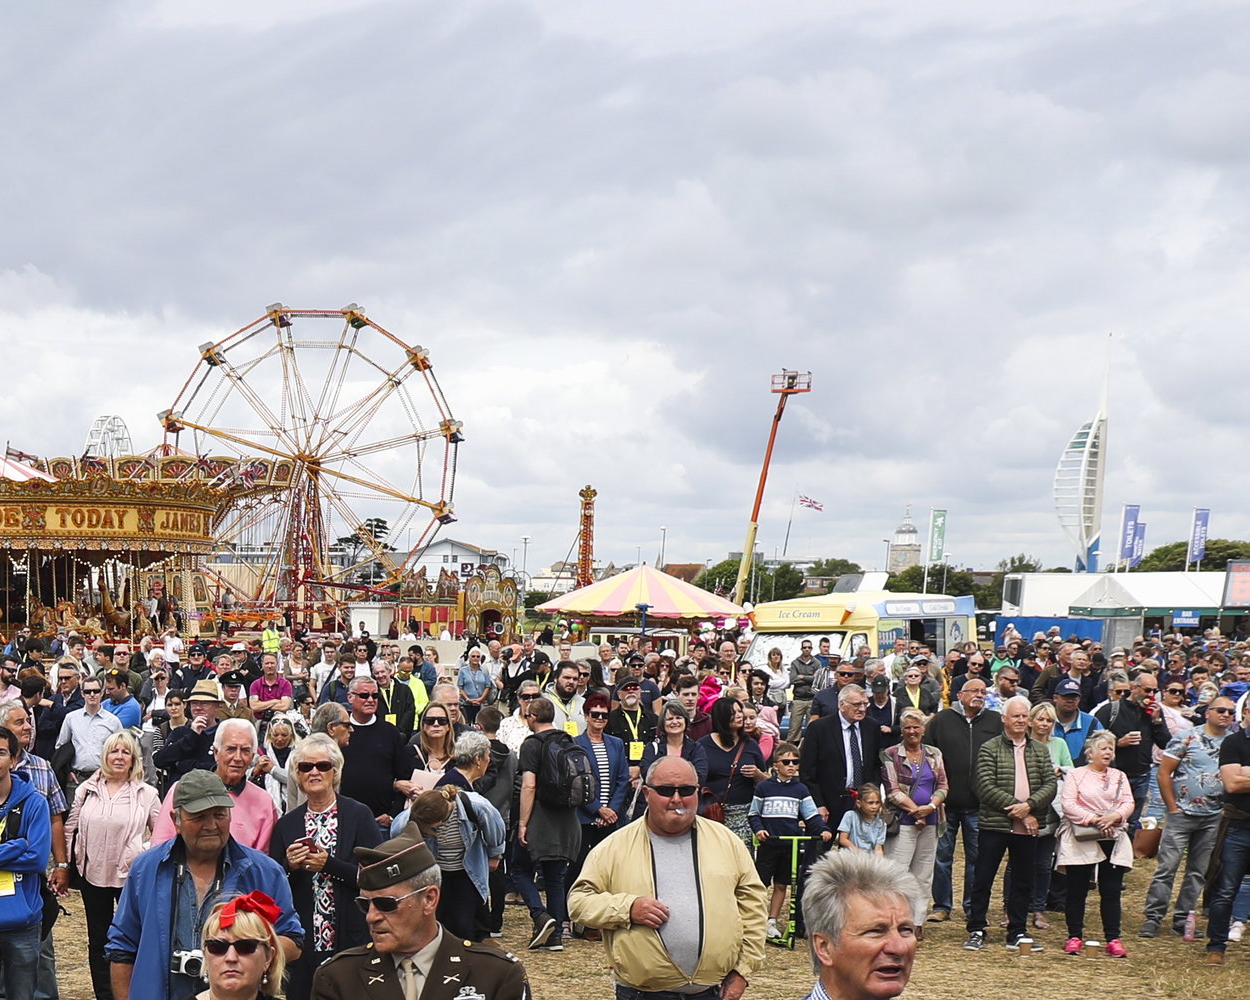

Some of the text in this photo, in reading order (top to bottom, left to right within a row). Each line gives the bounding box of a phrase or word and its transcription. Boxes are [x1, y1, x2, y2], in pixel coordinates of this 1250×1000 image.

[56, 508, 128, 529] TODAY
[160, 512, 201, 533] JAMES
[1125, 521, 1135, 549] TOILETS
[778, 609, 820, 619] Ice Cream
